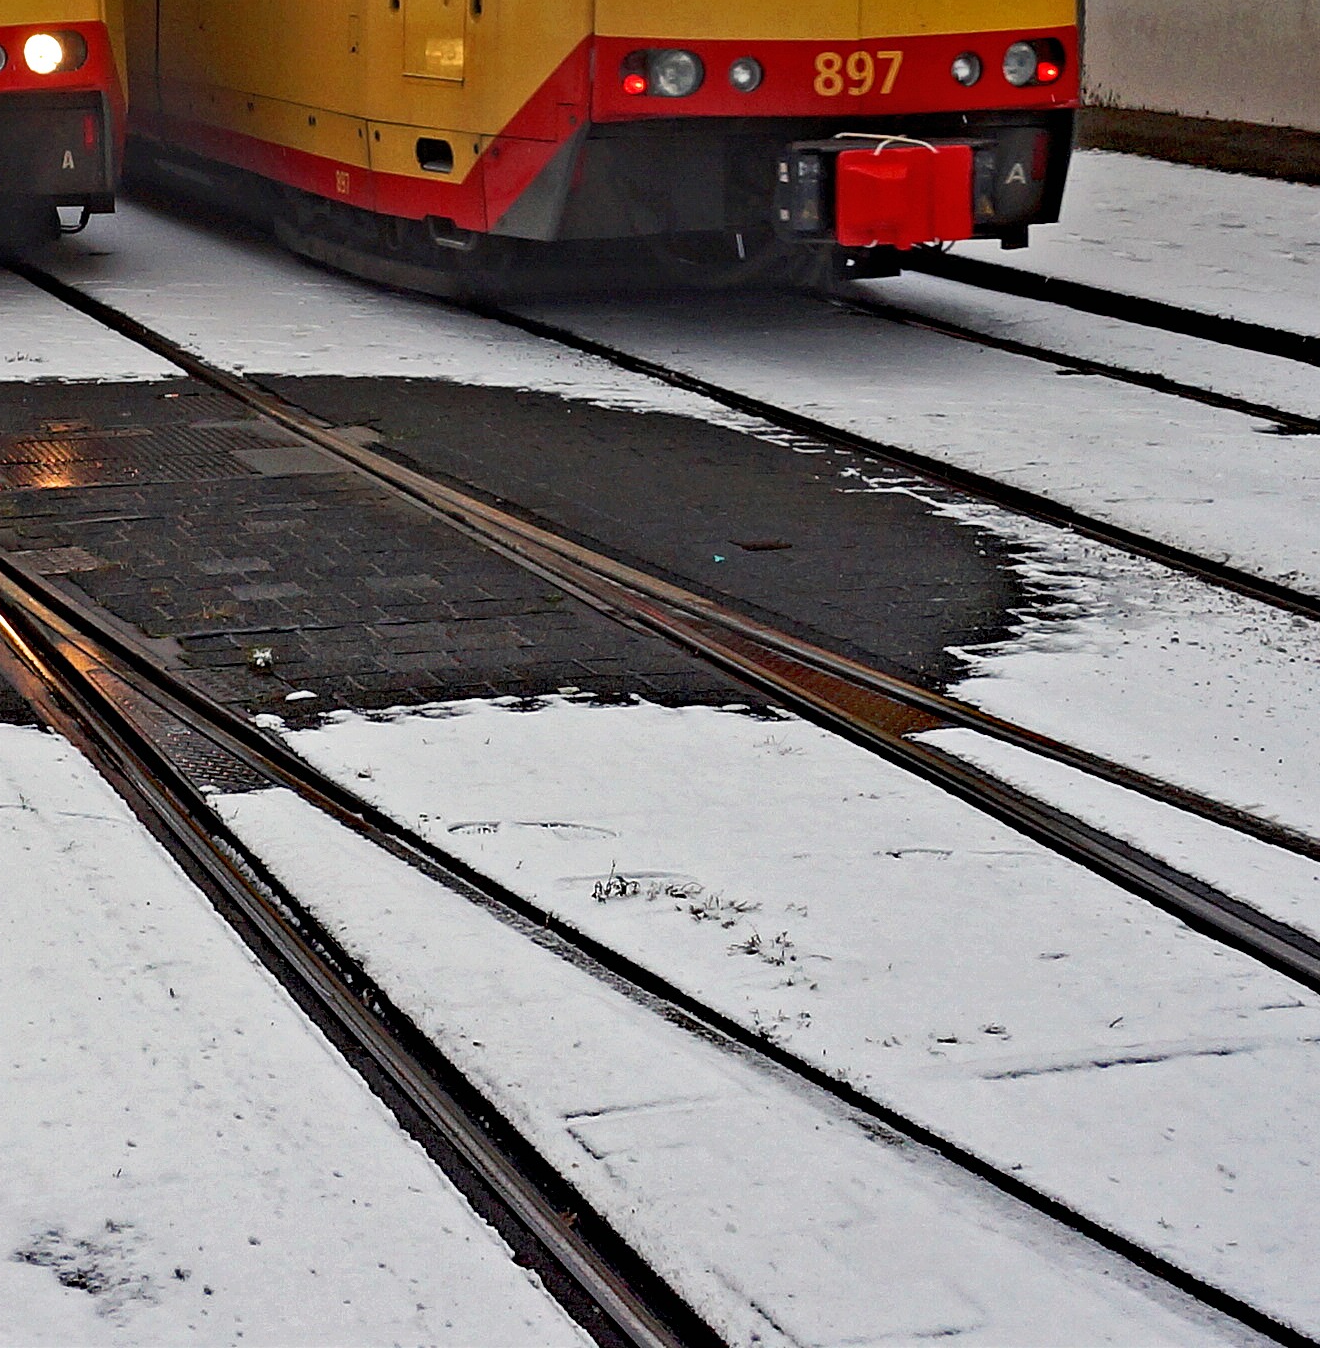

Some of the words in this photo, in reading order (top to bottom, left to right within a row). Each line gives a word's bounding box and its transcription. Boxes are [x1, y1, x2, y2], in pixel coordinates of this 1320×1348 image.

[813, 50, 904, 97] 897
[62, 150, 75, 169] A
[1005, 163, 1026, 184] A
